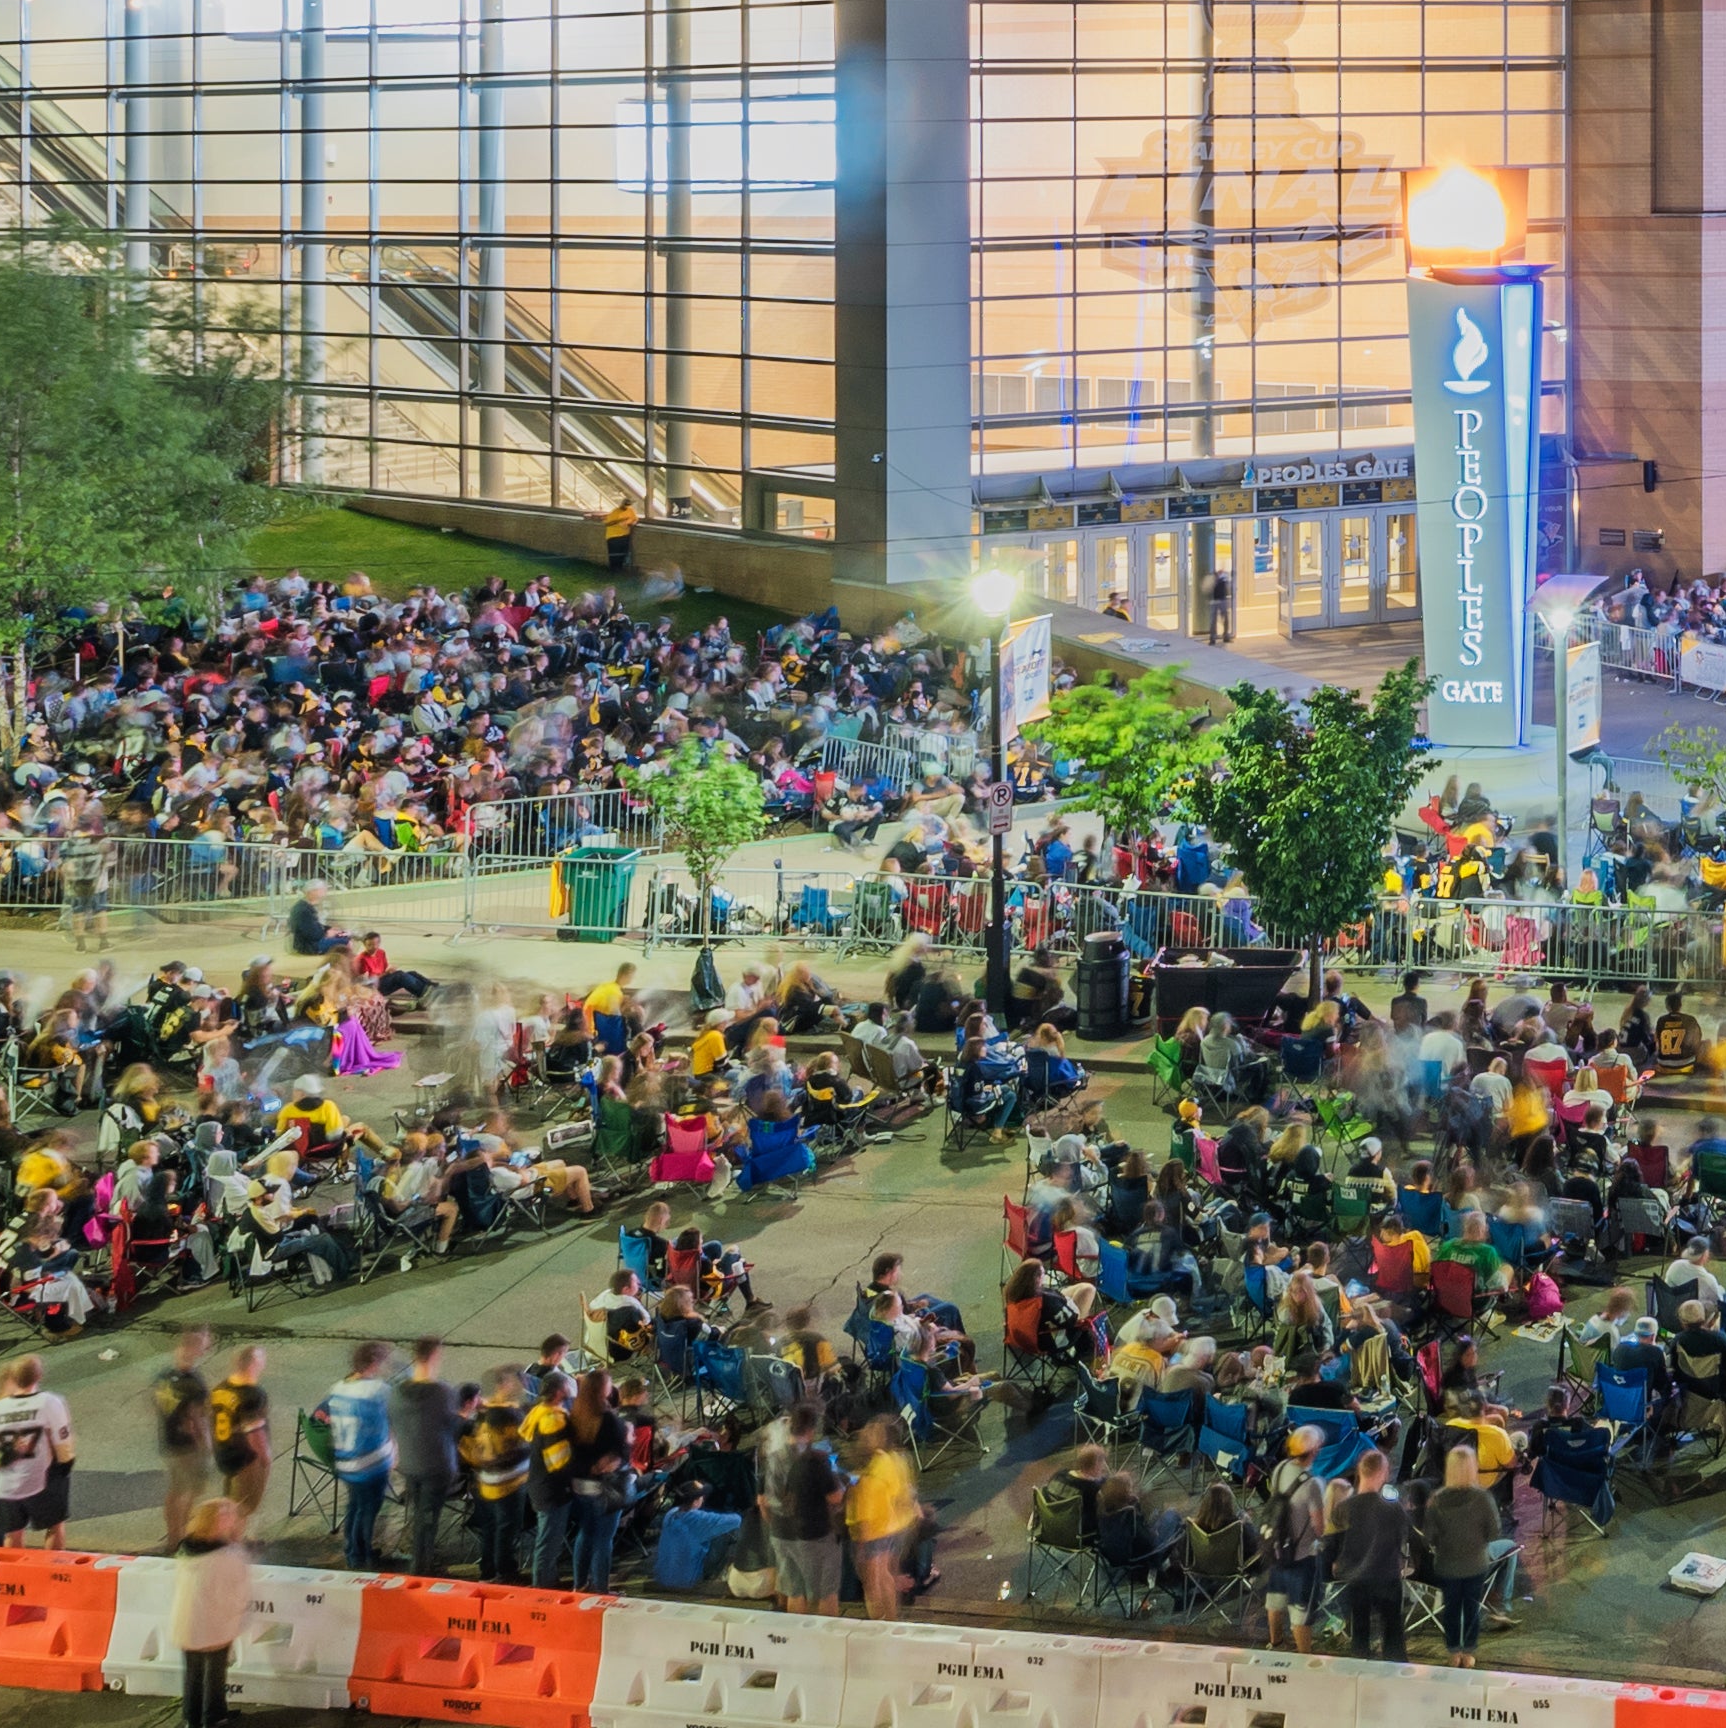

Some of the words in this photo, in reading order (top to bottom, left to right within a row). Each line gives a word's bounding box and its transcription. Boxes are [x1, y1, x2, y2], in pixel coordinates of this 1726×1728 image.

[1150, 137, 1286, 161] STANLEY
[1292, 136, 1355, 161] CUP
[1100, 165, 1398, 213] FINAL
[1257, 461, 1348, 486] PEOPLES
[1354, 458, 1409, 478] GATE
[1452, 409, 1488, 667] PEOPLES
[1441, 680, 1504, 704] GATE
[1660, 1028, 1686, 1055] 87
[447, 1616, 477, 1631] PGH
[481, 1620, 512, 1635] EMA
[689, 1640, 720, 1656] PGH
[724, 1644, 755, 1660] EMA
[1027, 1655, 1044, 1666] 032
[937, 1662, 969, 1677] PGH
[973, 1664, 1005, 1680] EMA
[1194, 1681, 1226, 1698] PGH
[1230, 1684, 1263, 1701] EMA
[1532, 1698, 1551, 1710] 055
[1449, 1705, 1482, 1721] PGH
[1486, 1709, 1519, 1725] EMA
